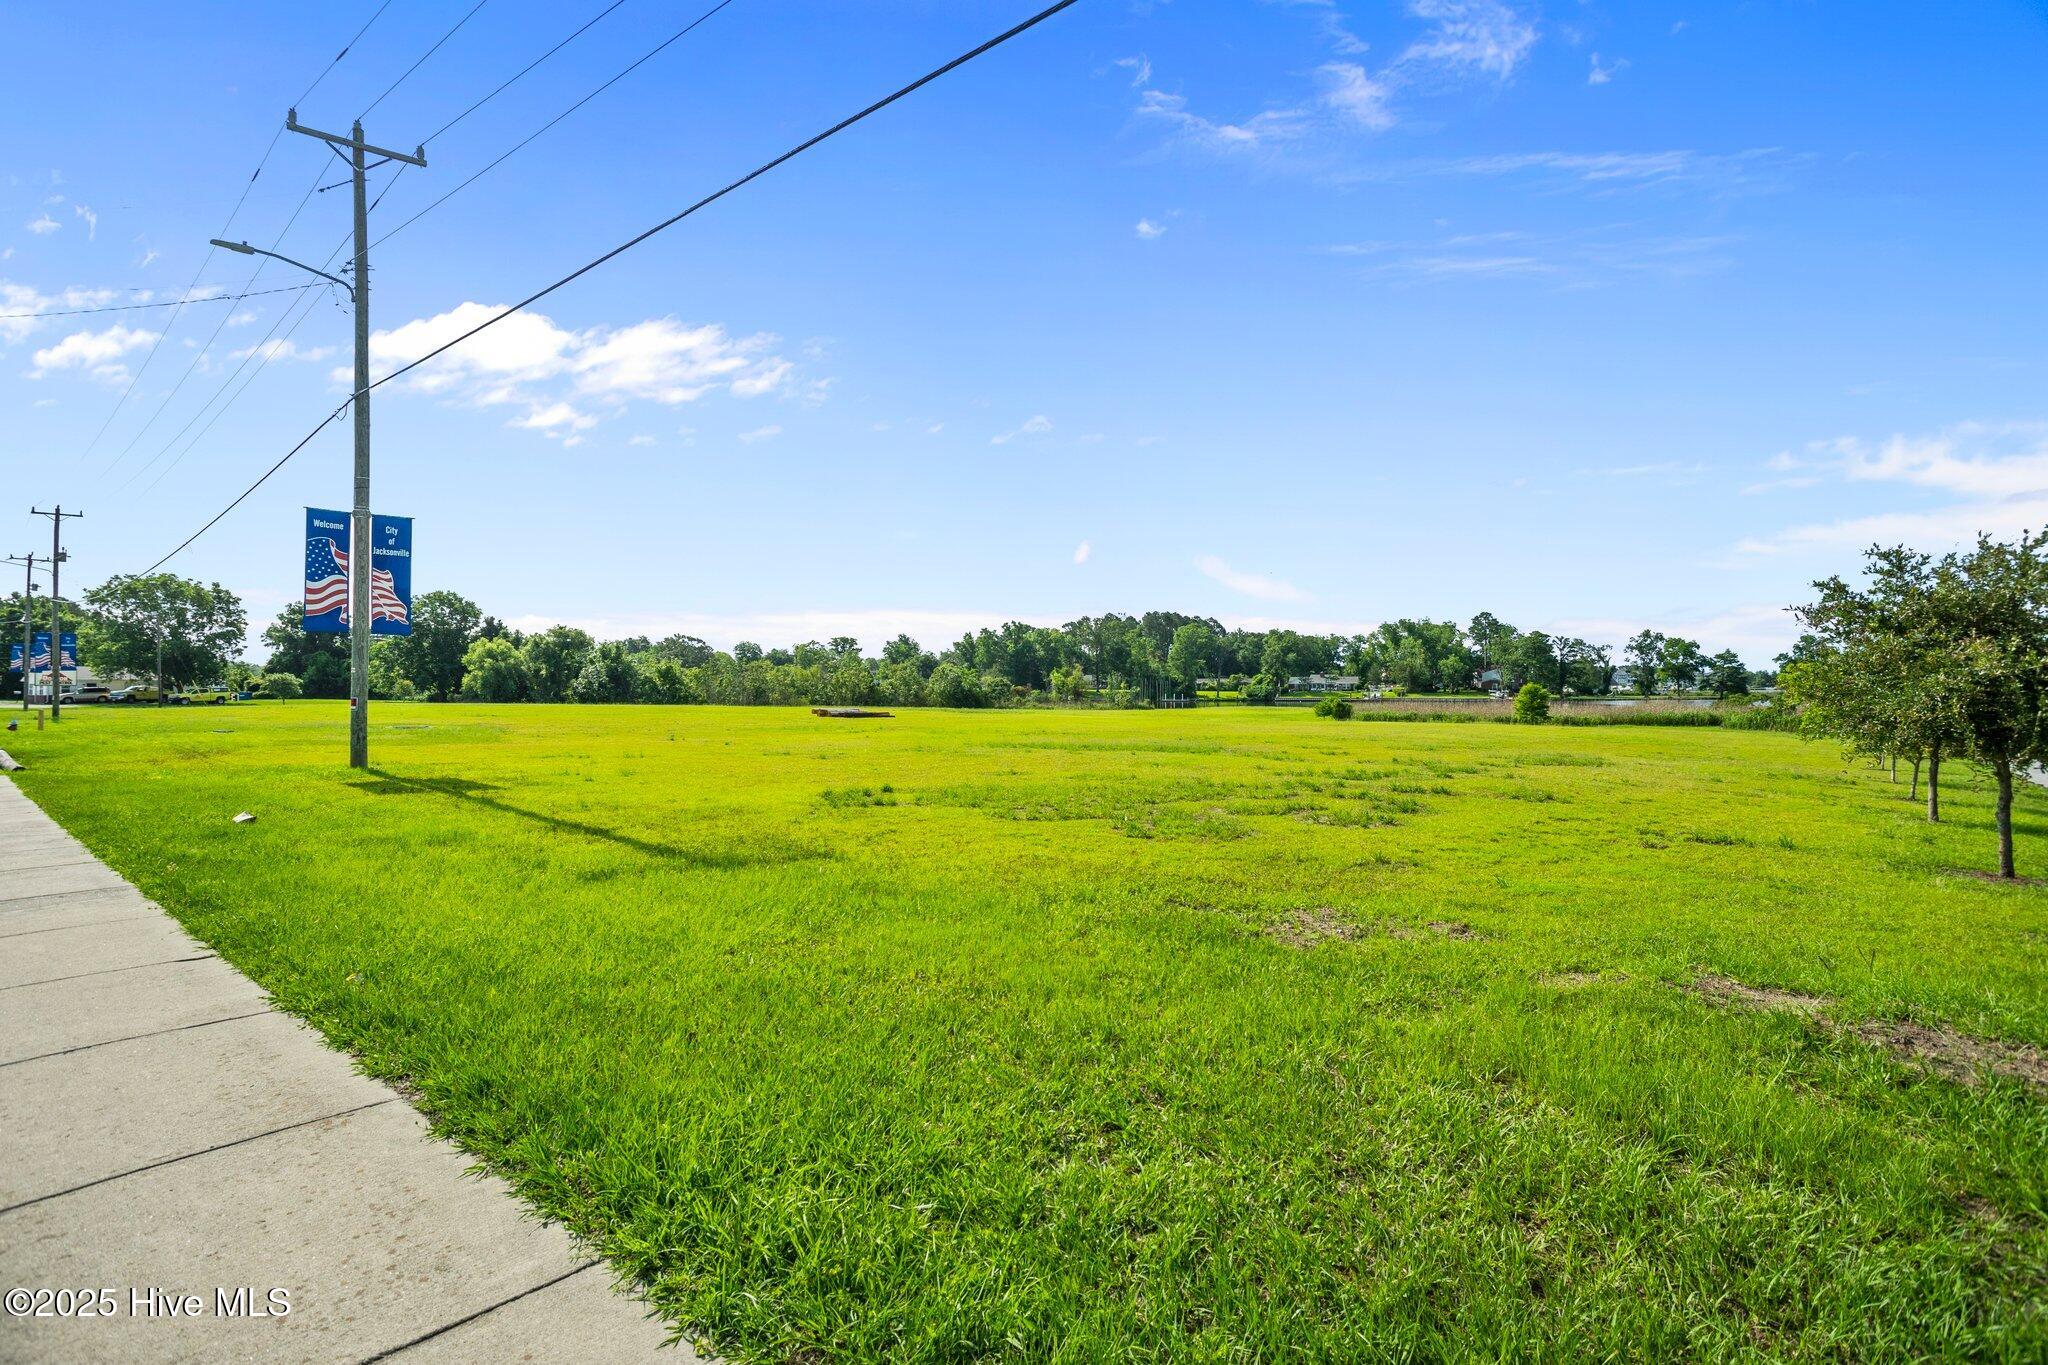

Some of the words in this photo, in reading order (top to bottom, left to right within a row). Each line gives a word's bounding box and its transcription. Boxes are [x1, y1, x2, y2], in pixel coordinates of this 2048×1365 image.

[313, 519, 344, 530] Welcome
[385, 526, 398, 536] City
[388, 538, 395, 546] of
[372, 547, 410, 557] Jacksonville
